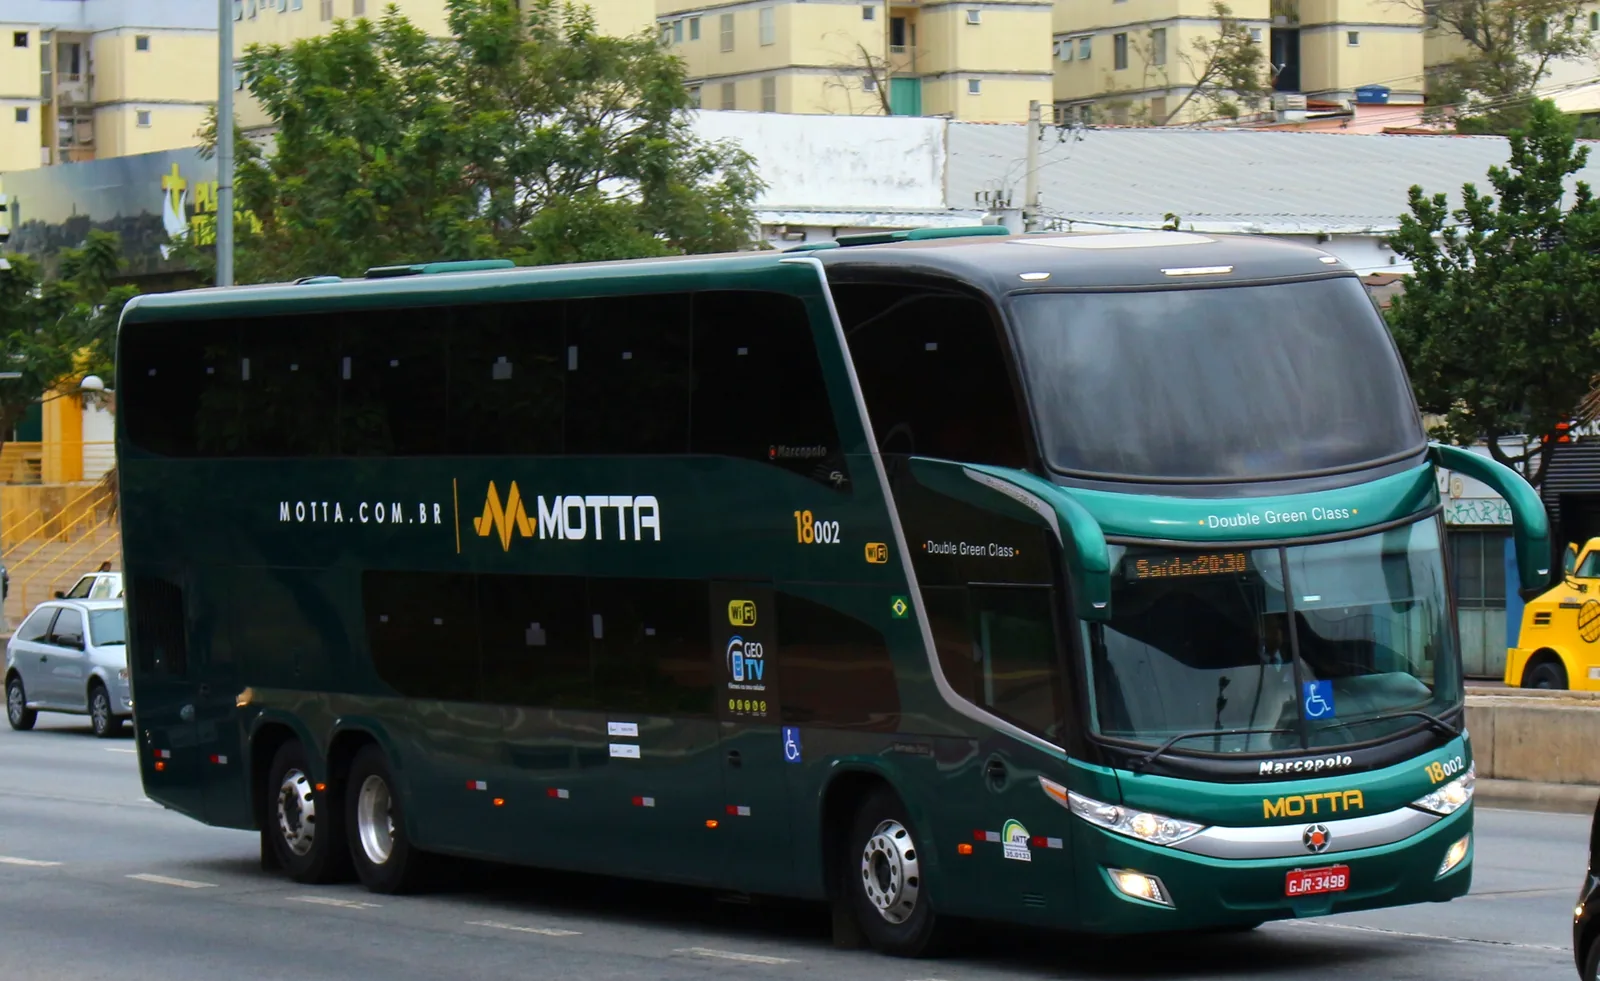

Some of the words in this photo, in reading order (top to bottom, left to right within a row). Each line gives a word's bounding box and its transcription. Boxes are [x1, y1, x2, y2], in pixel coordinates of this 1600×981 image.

[777, 444, 828, 459] Marcopolo
[279, 500, 442, 525] MOTTA.COM.BR
[537, 494, 661, 541] MOTTA
[1207, 511, 1260, 529] Double
[1264, 510, 1307, 524] Green
[1311, 507, 1349, 520] Class
[927, 540, 957, 555] Double
[959, 541, 986, 556] Green
[989, 543, 1014, 557] Class
[731, 604, 755, 622] WiFi
[744, 642, 763, 658] GEO
[744, 659, 764, 680] TV
[1259, 755, 1353, 775] Marcopolo
[1262, 789, 1364, 819] MOTTA
